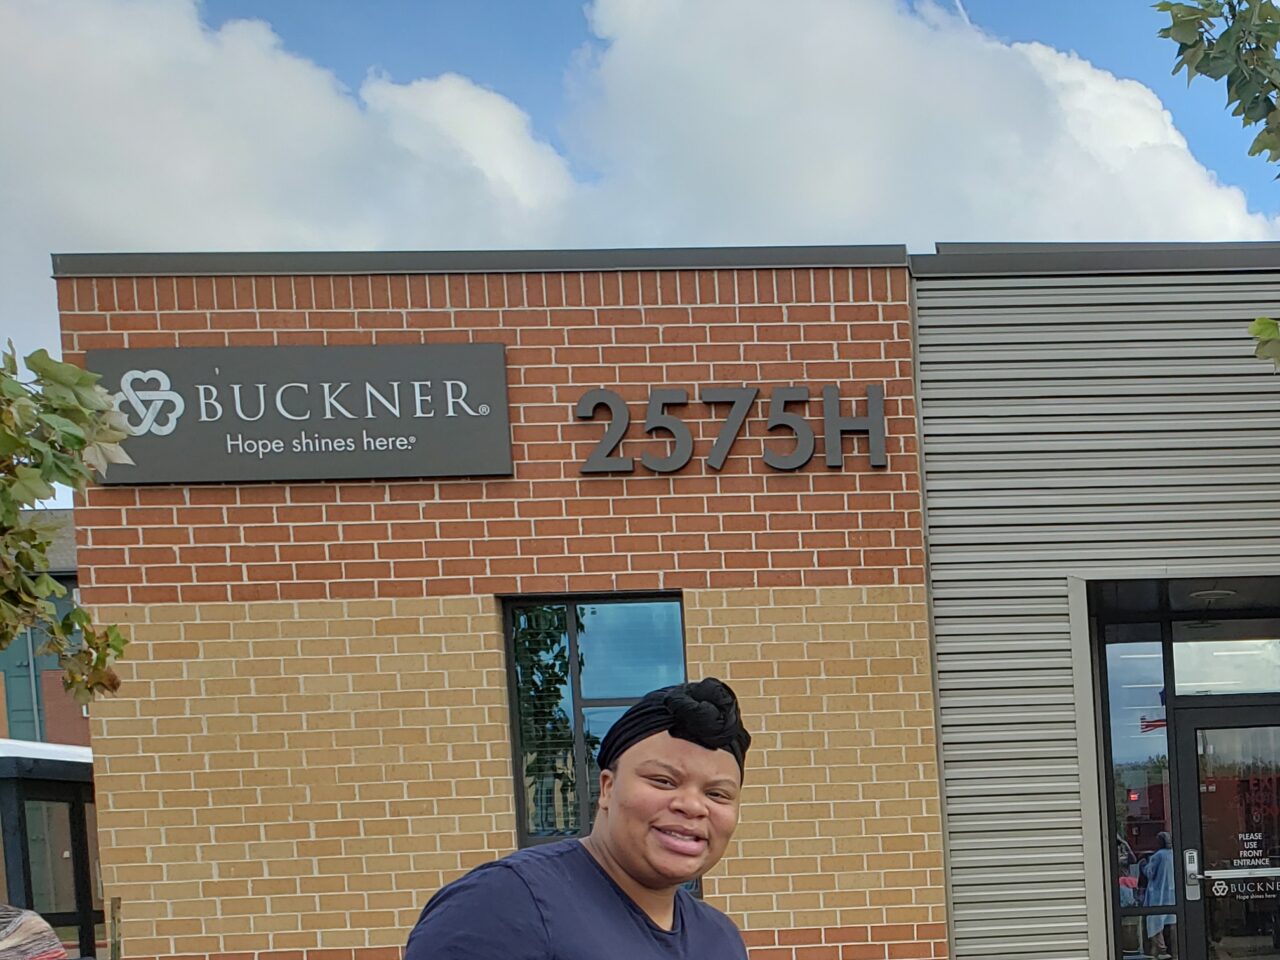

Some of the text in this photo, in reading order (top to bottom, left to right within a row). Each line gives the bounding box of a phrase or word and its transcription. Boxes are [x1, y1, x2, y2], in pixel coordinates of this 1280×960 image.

[576, 384, 887, 473] 2575H
[226, 434, 284, 458] Hope
[291, 431, 355, 453] shines
[1238, 833, 1263, 841] PLEASE
[1244, 841, 1258, 849] USE
[1239, 850, 1263, 858] FRONT
[1233, 858, 1270, 867] ENTRANCE
